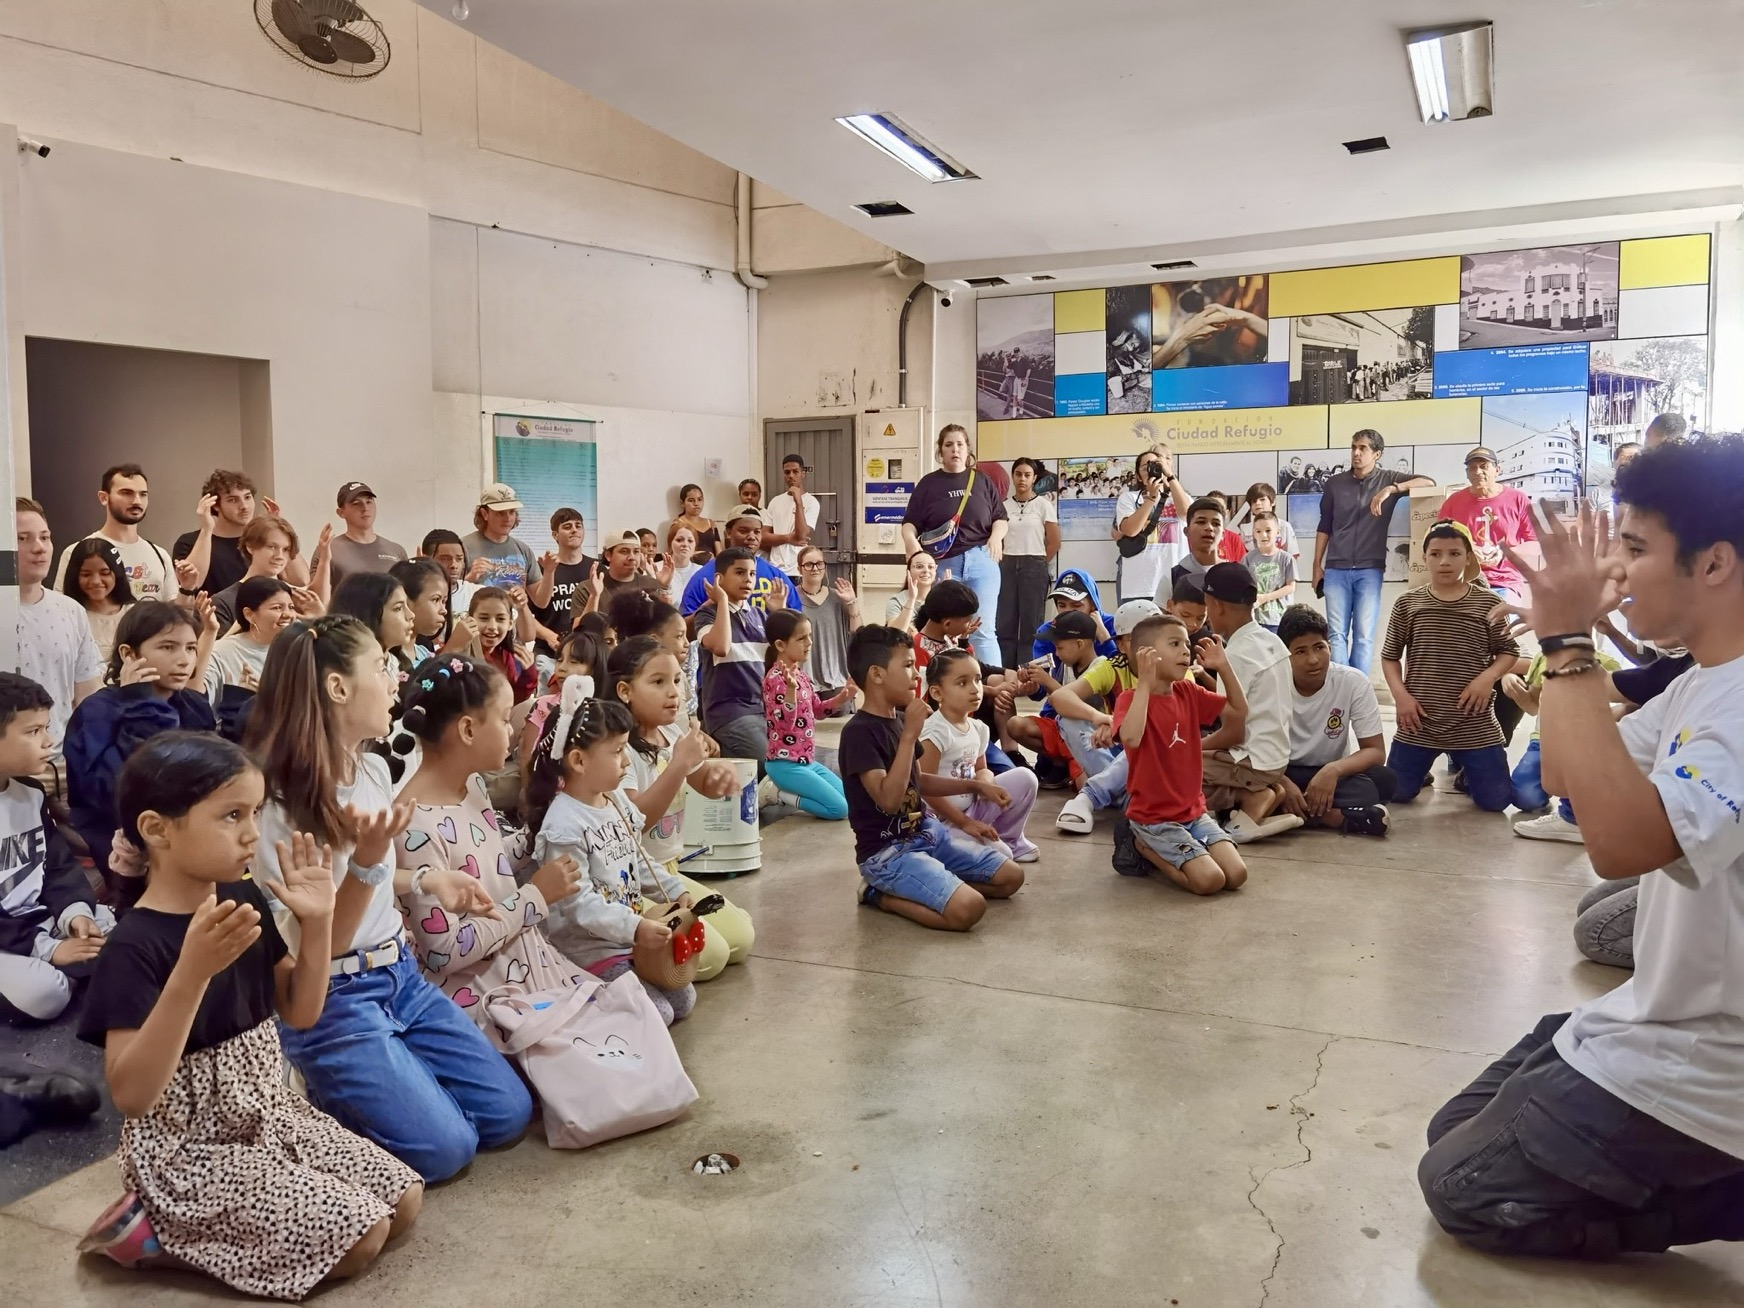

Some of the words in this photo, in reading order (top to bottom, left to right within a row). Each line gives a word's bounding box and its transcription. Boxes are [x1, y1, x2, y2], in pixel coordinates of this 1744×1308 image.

[1166, 427, 1218, 440] Ciudad
[1224, 424, 1282, 440] Refugio
[552, 600, 571, 612] WO
[1701, 780, 1716, 792] City
